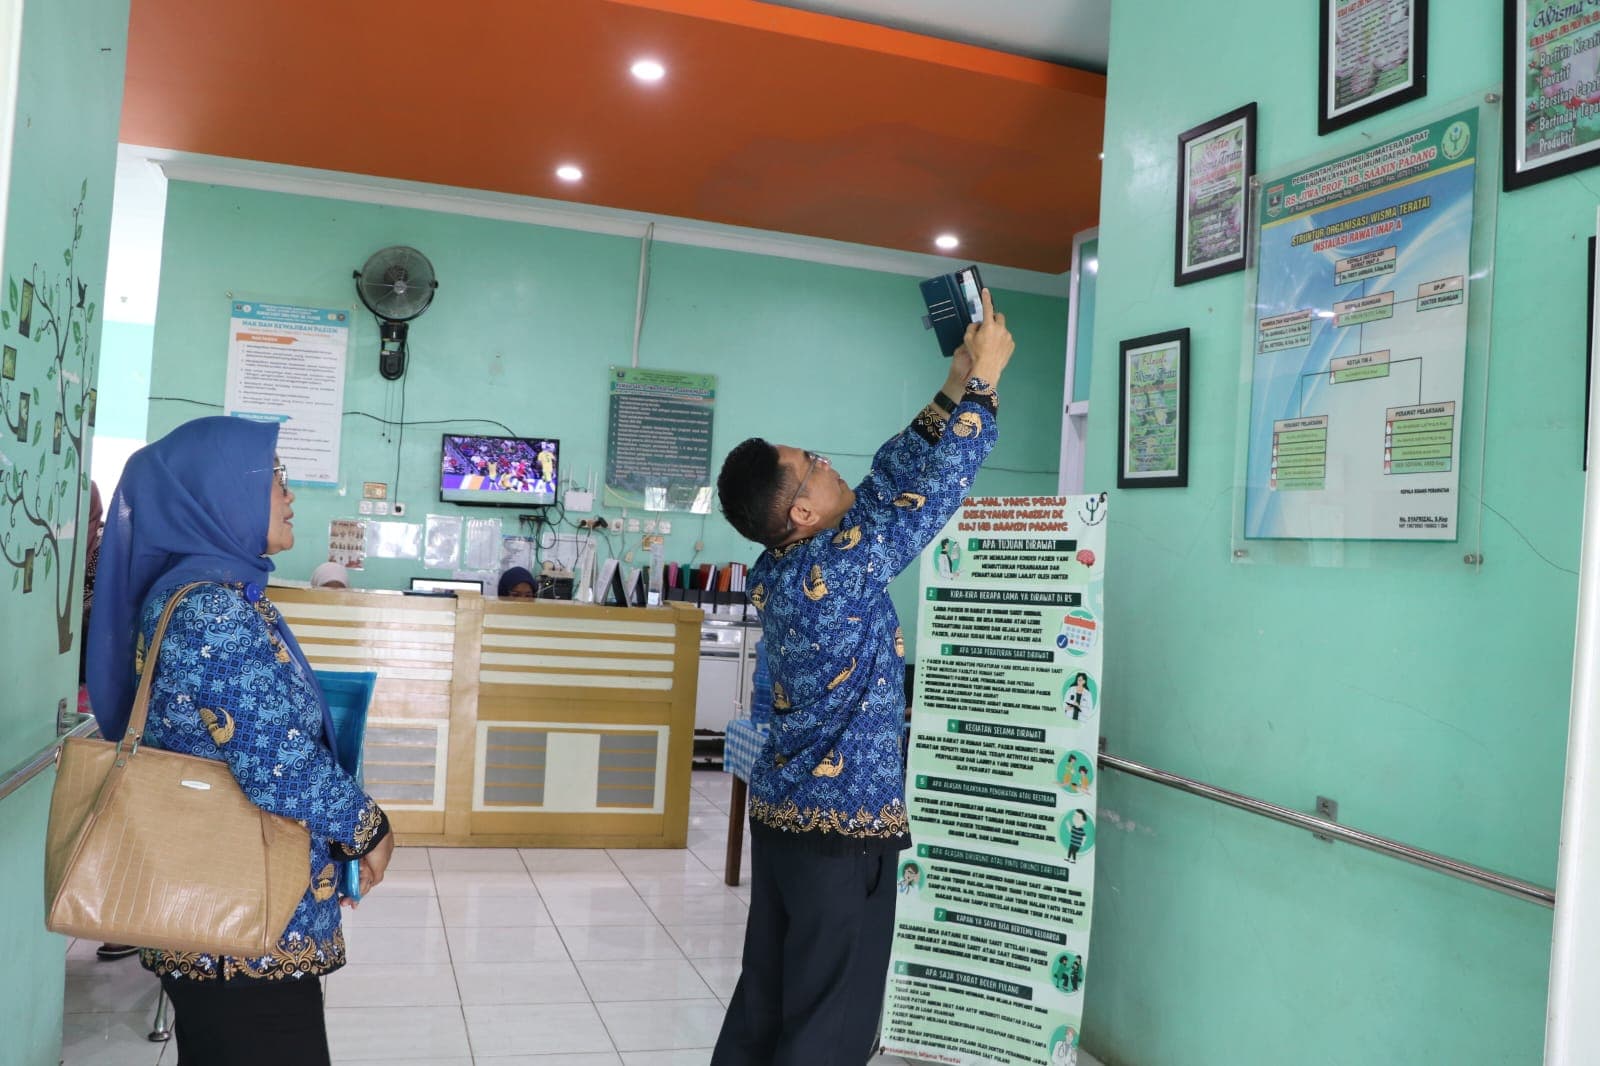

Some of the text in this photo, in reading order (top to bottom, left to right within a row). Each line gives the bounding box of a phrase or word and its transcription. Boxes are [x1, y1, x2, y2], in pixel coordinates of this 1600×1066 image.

[1534, 2, 1583, 27] Wisma
[1540, 64, 1571, 88] Inovatif
[1540, 89, 1573, 109] Bersikap
[1540, 102, 1600, 130] Bertindak Tepa
[1540, 128, 1575, 152] Produktif
[1292, 131, 1429, 185] PEMERINTAH PROVINSI SUMATERA BARAT
[1305, 146, 1411, 188] BADAN LAYANAN UMUM DAERAH
[1300, 185, 1318, 202] JIWA
[1364, 160, 1396, 182] SAANIN
[1398, 147, 1436, 171] PADANG
[1292, 196, 1431, 247] STRUKTUR ORGANISASI WISMA TERATAI
[1313, 219, 1402, 252] INSTALASI RAWAT INAP A
[963, 497, 1001, 506] AL-HAL
[1032, 497, 1067, 506] PERLU
[1028, 522, 1068, 531] PADANG
[982, 540, 1057, 550] APA TUJUAN DIRAWAT
[950, 589, 1072, 603] KIRA-KIRA BERAPA LAMA YA DIRAWAT DI RS
[960, 646, 1049, 659] APA SAJA PERATURAN SAAT DIRAWAT
[965, 723, 1041, 739] KEGIATAN SELAMA DIRAWAT
[943, 782, 961, 790] ALASAN
[1019, 792, 1031, 800] ATAU
[932, 847, 941, 855] APA
[944, 849, 963, 858] ALASAN
[990, 857, 1002, 865] ATAU
[956, 913, 1061, 940] KAPAN YA SAYA BISA BERTEMU KELUARGA
[925, 968, 937, 978] APA
[939, 971, 954, 981] SAJA
[956, 974, 977, 986] SYARAT
[979, 978, 996, 989] BOLEH
[999, 981, 1019, 994] PULANG
